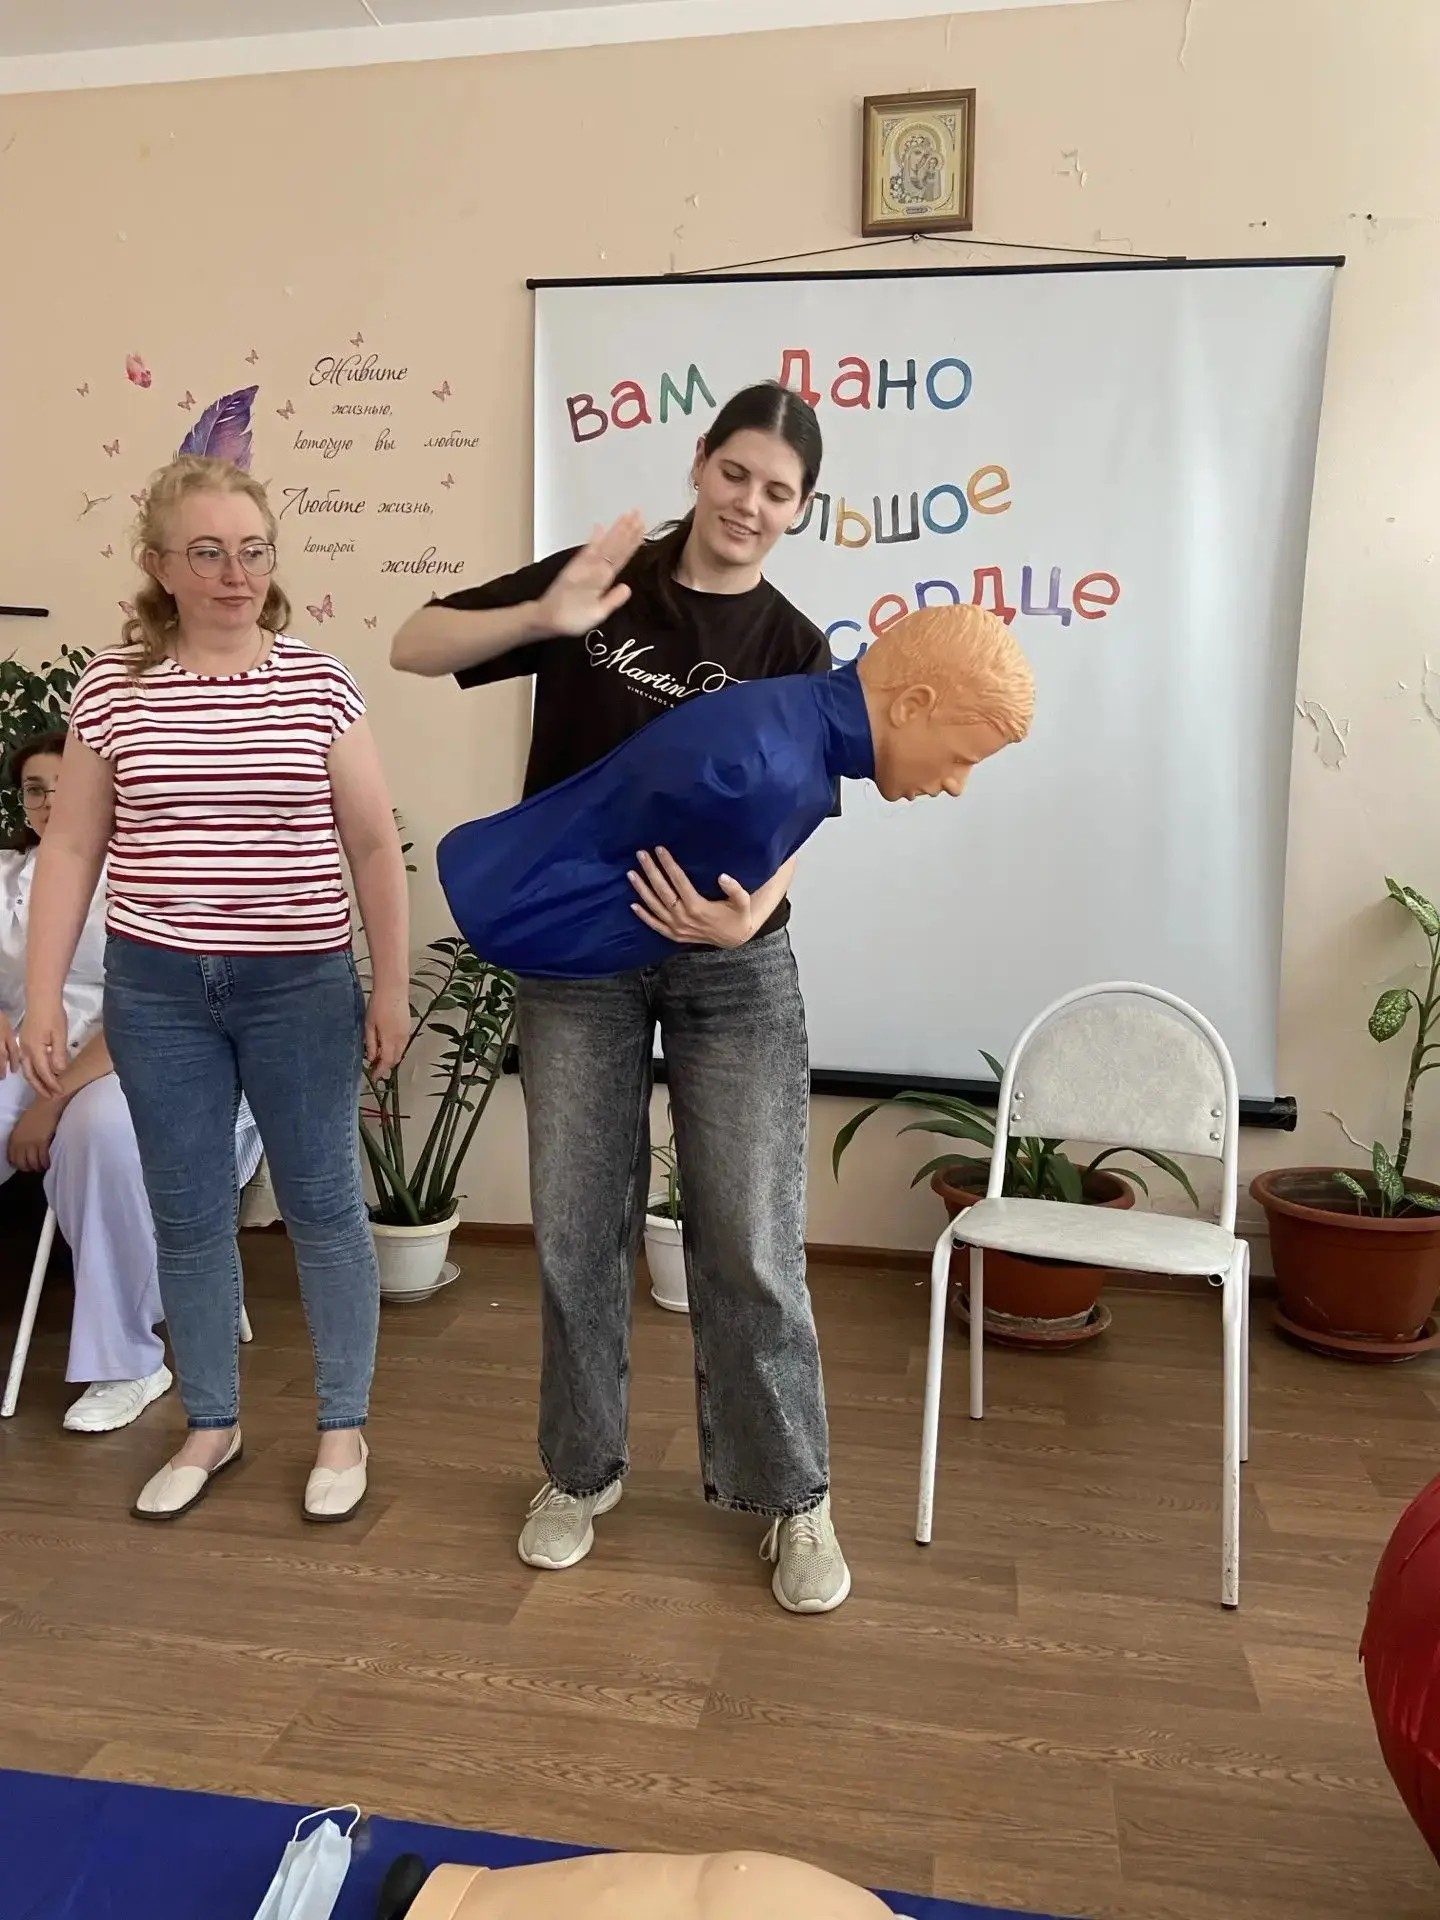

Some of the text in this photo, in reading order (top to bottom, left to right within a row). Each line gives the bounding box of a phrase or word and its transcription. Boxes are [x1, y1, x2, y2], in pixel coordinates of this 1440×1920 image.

[309, 354, 408, 386] Живите
[331, 403, 393, 416] жизнью,
[293, 428, 480, 459] которую вы любите
[280, 487, 434, 520] Любите жизнь,
[784, 464, 1012, 548] льшое
[304, 536, 356, 560] которой
[381, 546, 465, 574] живете
[585, 629, 700, 698] Martin
